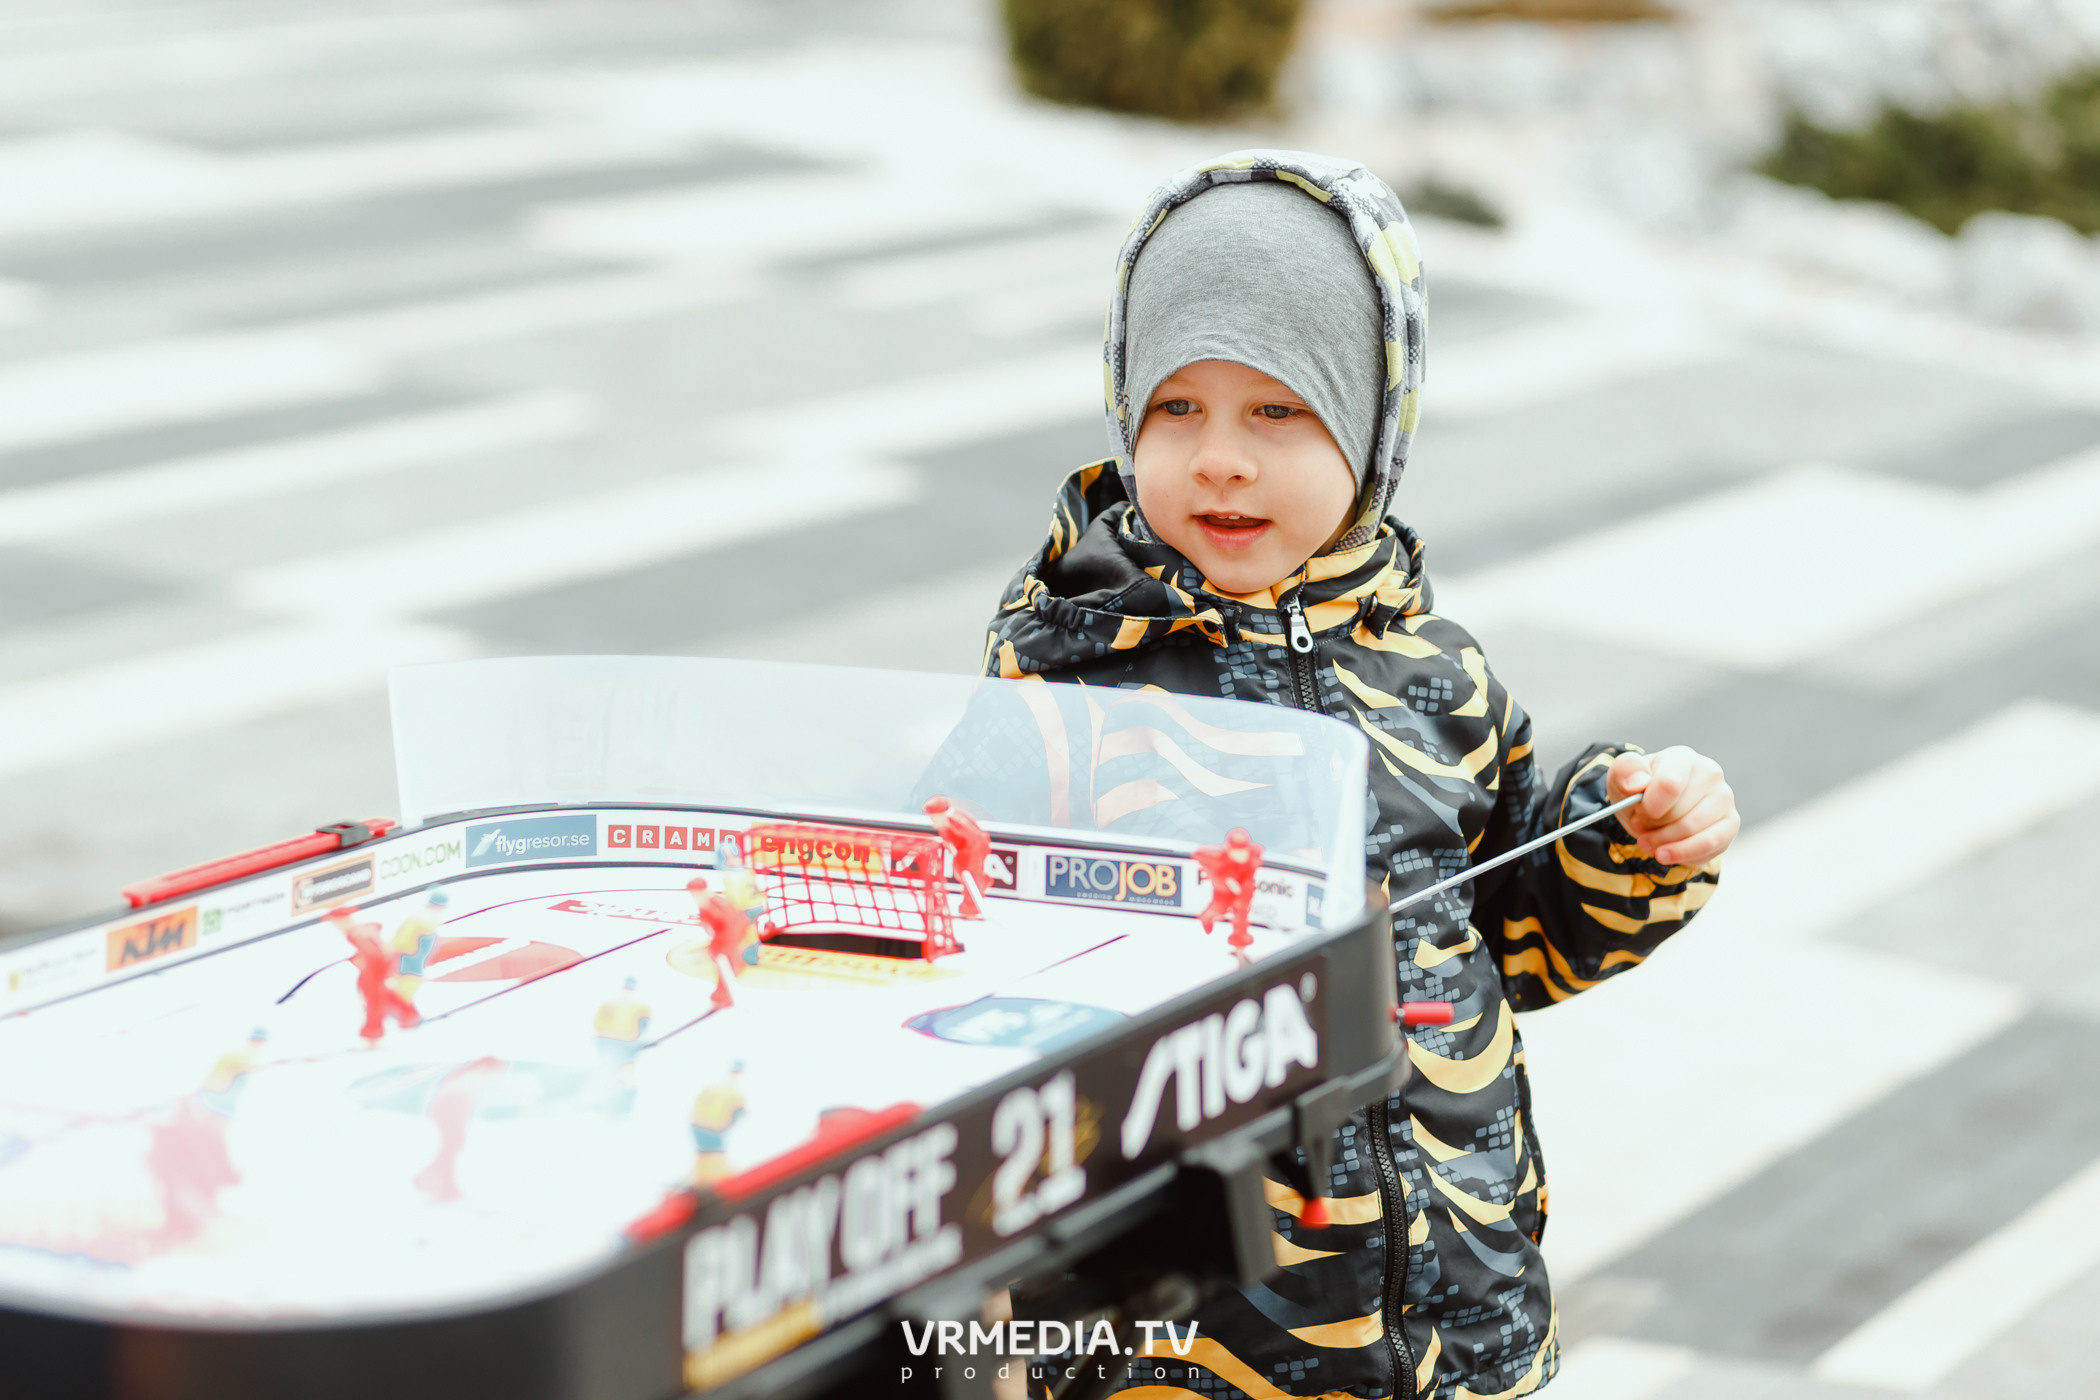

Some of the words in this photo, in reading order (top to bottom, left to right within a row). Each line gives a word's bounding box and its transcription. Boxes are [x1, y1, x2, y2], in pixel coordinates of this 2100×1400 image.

[495, 833, 590, 856] flygresor.se
[760, 835, 871, 863] engcon
[1049, 856, 1178, 901] PROJOB
[1121, 983, 1319, 1160] STIGA
[683, 1174, 841, 1352] PLAY
[839, 1121, 959, 1273] OFF
[991, 1068, 1086, 1237] 21
